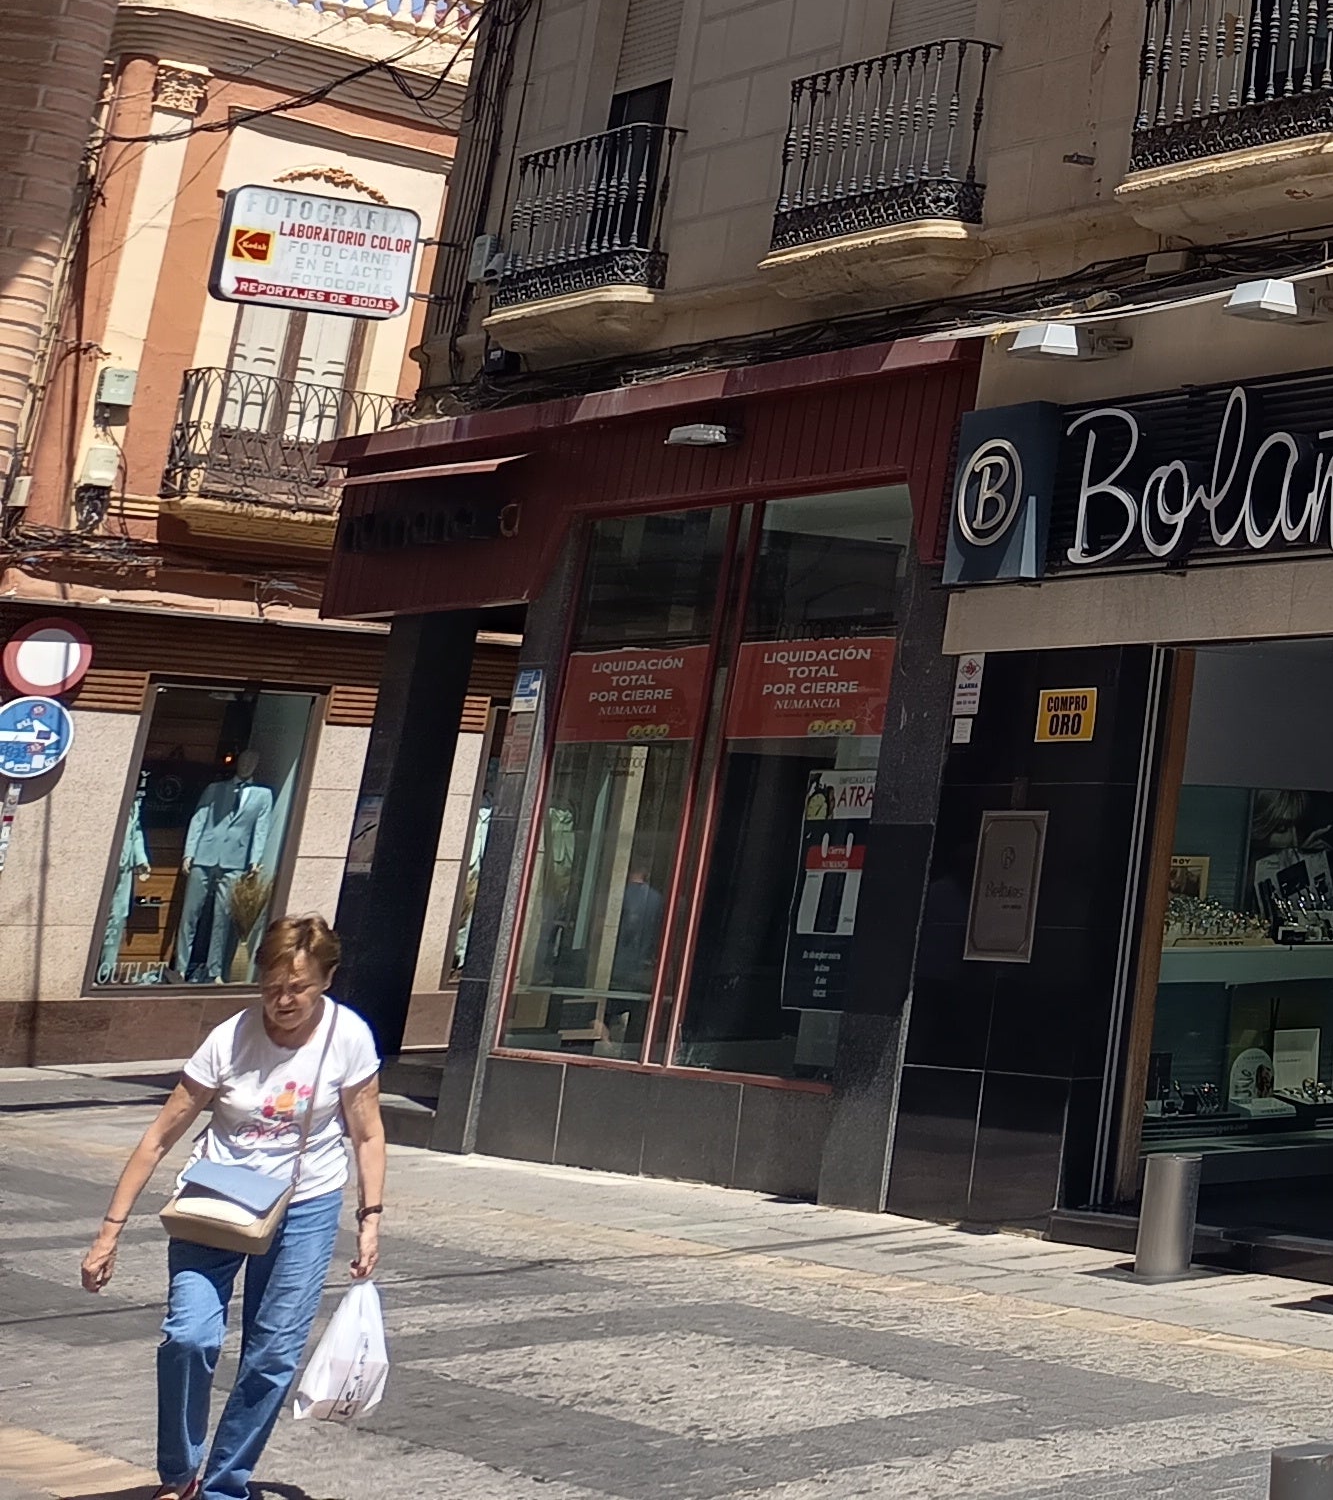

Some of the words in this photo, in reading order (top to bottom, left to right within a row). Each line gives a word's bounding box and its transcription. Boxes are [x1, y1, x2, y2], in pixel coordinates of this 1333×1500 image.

[242, 240, 268, 250] Kodak
[279, 221, 366, 247] LABORATORIO
[371, 237, 412, 254] COLOR
[288, 241, 332, 257] FOTO
[338, 248, 402, 265] CARNET
[295, 257, 316, 270] EN
[323, 261, 343, 275] EL
[351, 263, 393, 281] ACTO
[290, 272, 393, 297] FOTOCOPIAS
[239, 281, 325, 302] REPORTAJES
[329, 294, 347, 305] DE
[351, 296, 394, 310] BODAS
[763, 645, 872, 665] LIQUIDACIÓN
[591, 656, 684, 674] LIQUIDACIÓN
[787, 665, 839, 678] TOTAL
[611, 674, 656, 687] TOTAL
[762, 684, 796, 696] POR
[800, 681, 859, 695] CIERRE
[589, 691, 618, 703] POR
[622, 688, 673, 701] CIERRE
[773, 698, 841, 710] NUMANCIA
[1046, 694, 1088, 713] COMPRO
[598, 704, 657, 716] NUMANCIA
[1048, 713, 1083, 736] ORO
[97, 961, 169, 985] OUTLET
